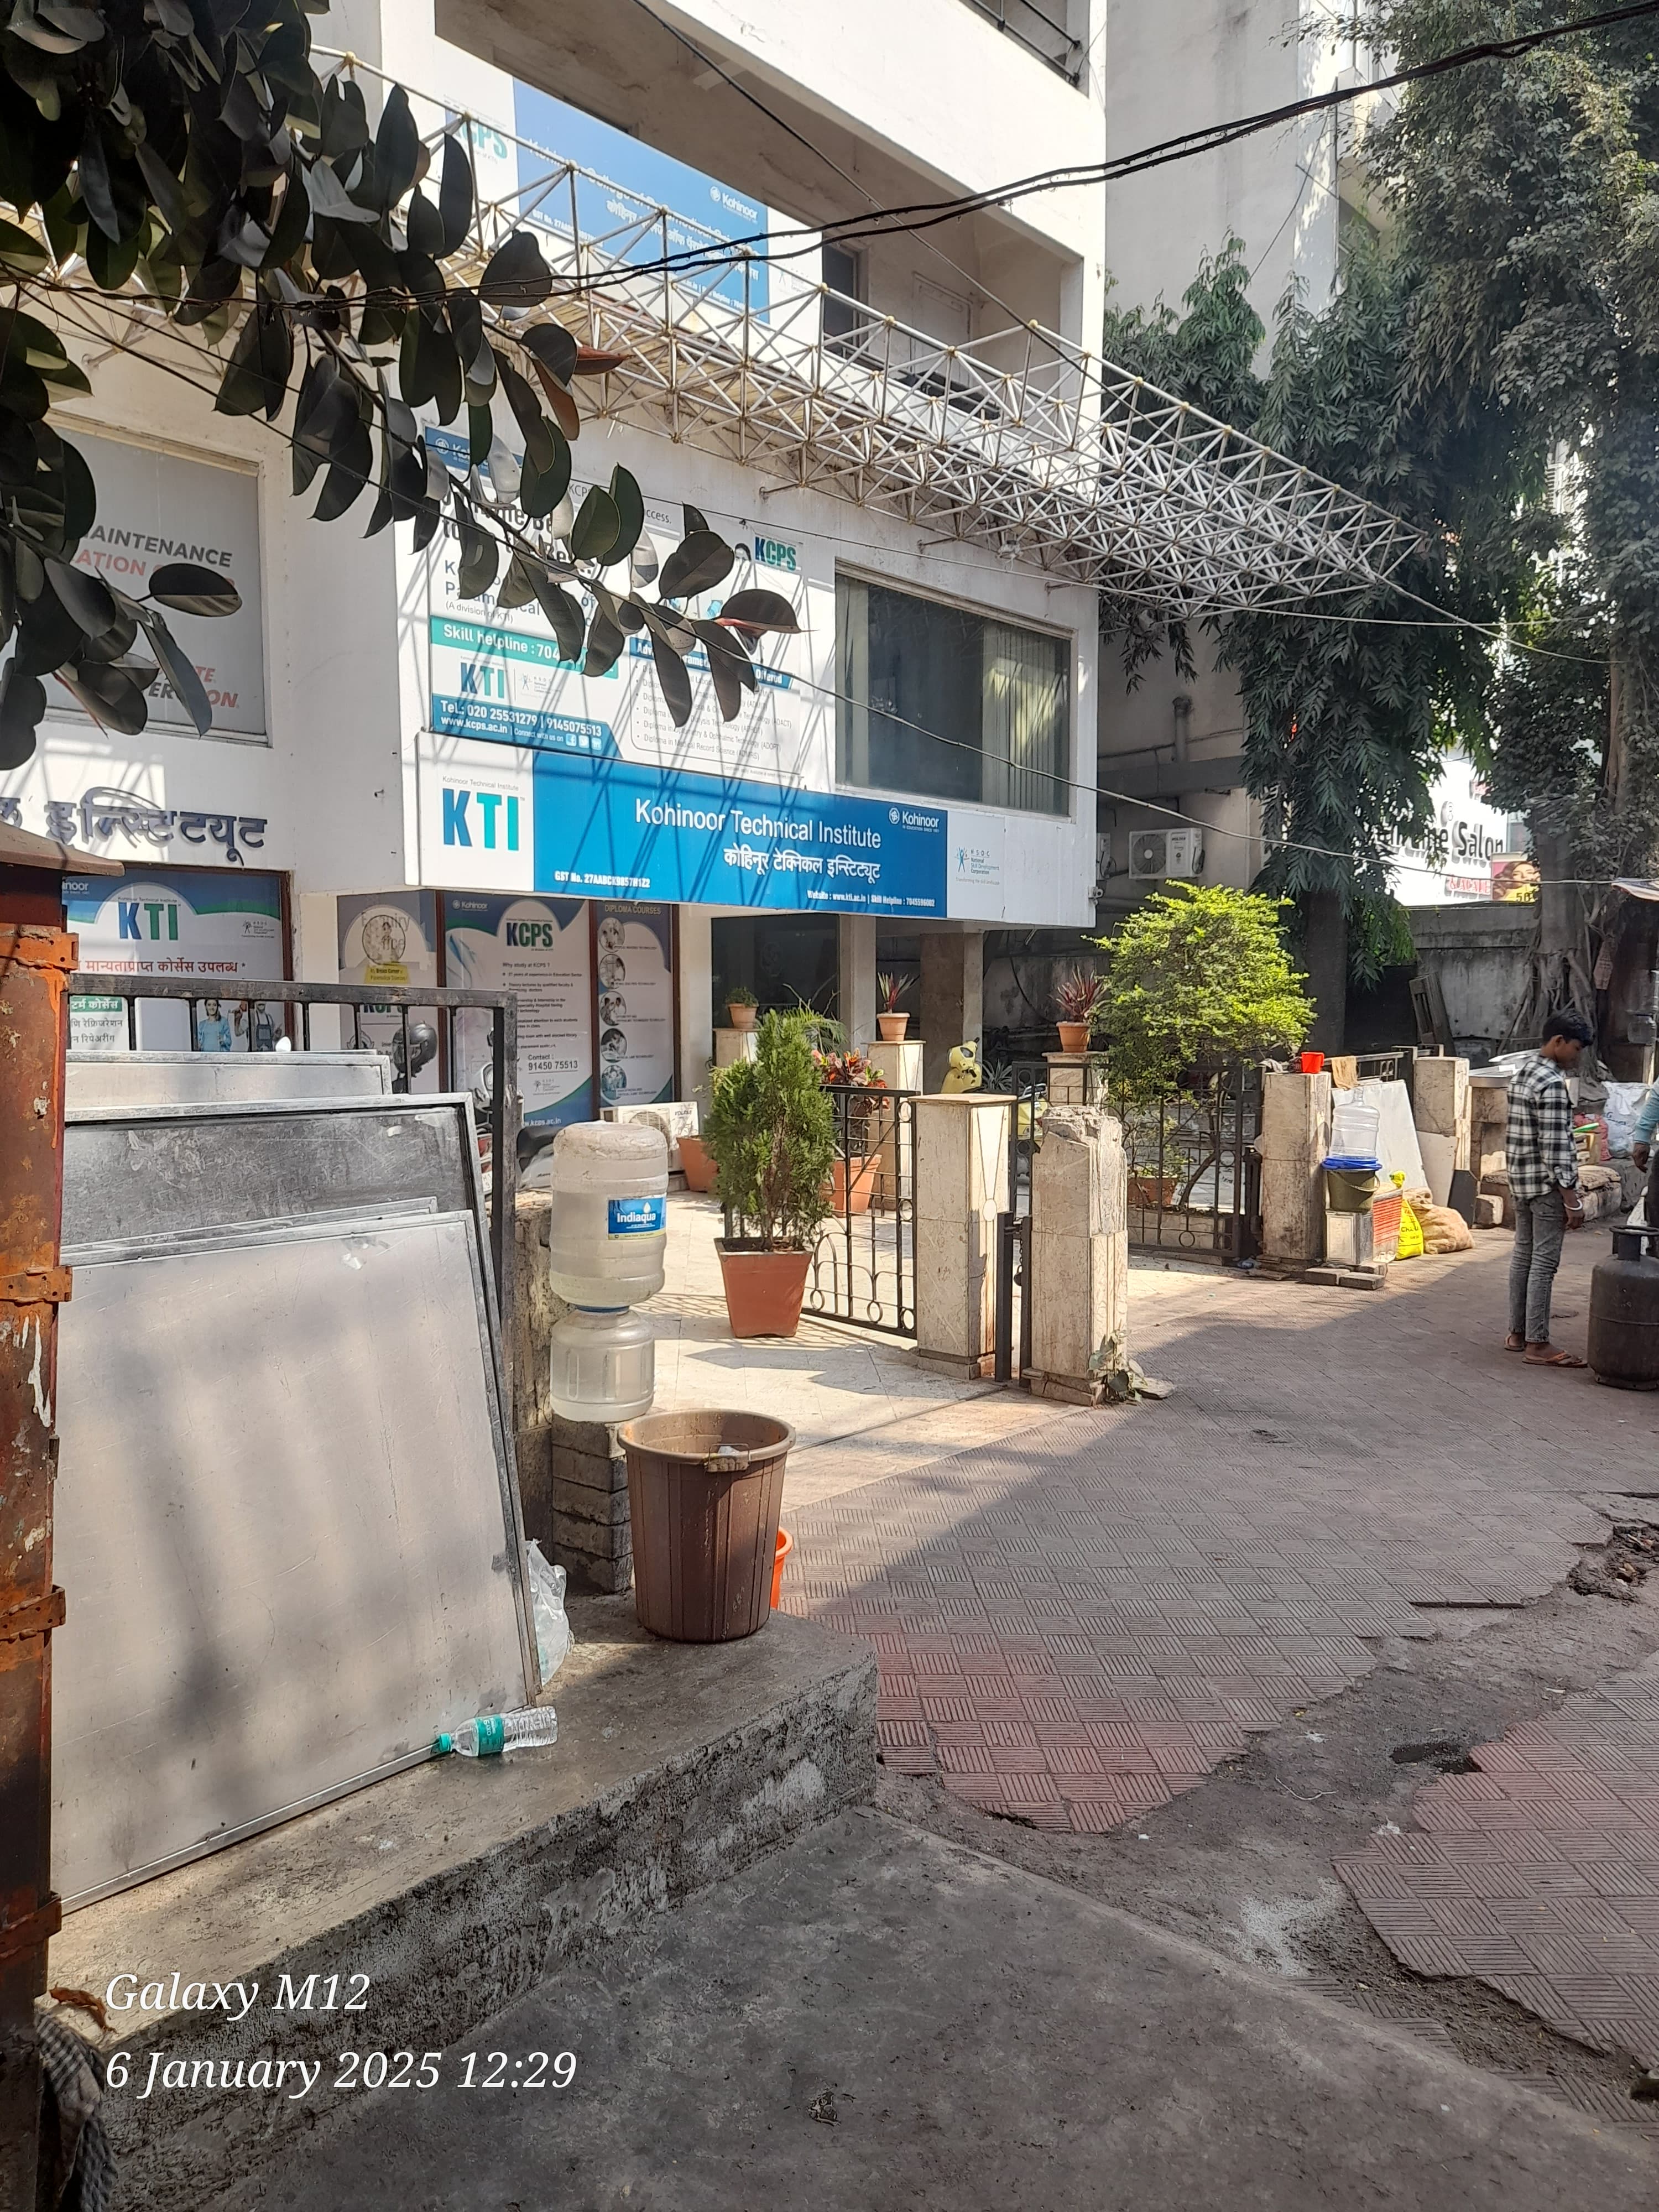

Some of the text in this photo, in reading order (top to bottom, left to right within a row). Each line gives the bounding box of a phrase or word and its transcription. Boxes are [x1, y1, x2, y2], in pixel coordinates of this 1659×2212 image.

[722, 192, 758, 219] Kohinoor
[568, 483, 589, 497] KCP
[646, 508, 672, 525] ccess.
[85, 525, 233, 568] AINTENANCE
[754, 537, 796, 571] KCPS
[75, 549, 146, 576] ATION
[456, 603, 485, 615] division
[444, 624, 474, 643] Skill
[477, 631, 528, 654] helpline
[460, 662, 505, 699] KTI
[440, 716, 508, 734] www.kcps.ac.in
[514, 727, 536, 738] Connect
[537, 731, 548, 739] with
[467, 705, 488, 718] 020
[490, 708, 538, 727] 25531279
[546, 717, 602, 737] 9145075513
[644, 734, 667, 744] Diploma
[697, 743, 714, 753] Record
[442, 775, 519, 791] Kohinoor Technical Institute
[442, 788, 519, 851] KTI
[636, 798, 881, 849] Kohinoor Technical Institute
[902, 810, 940, 828] Kohinoor
[1458, 821, 1504, 861] Salon
[723, 842, 770, 875] कोहिनूर
[773, 847, 823, 874] टेक्निकल
[555, 870, 570, 881] GST
[570, 872, 583, 883] No.
[461, 900, 488, 910] Kohinoor
[807, 889, 828, 900] Website
[832, 893, 866, 903] www.kti.ac.in
[871, 894, 882, 904] Skill
[883, 895, 902, 906] Helpline
[605, 904, 661, 915] DIPLOMA COURSES
[118, 902, 179, 941] KTI
[506, 922, 554, 948] KCPS
[86, 957, 238, 974] मान्यताप्राप्त कोर्सेस उपलब्ध
[88, 998, 118, 1010] कोर्सेस
[528, 1061, 578, 1071] 91450 75513
[617, 1212, 656, 1224] Indiaqua
